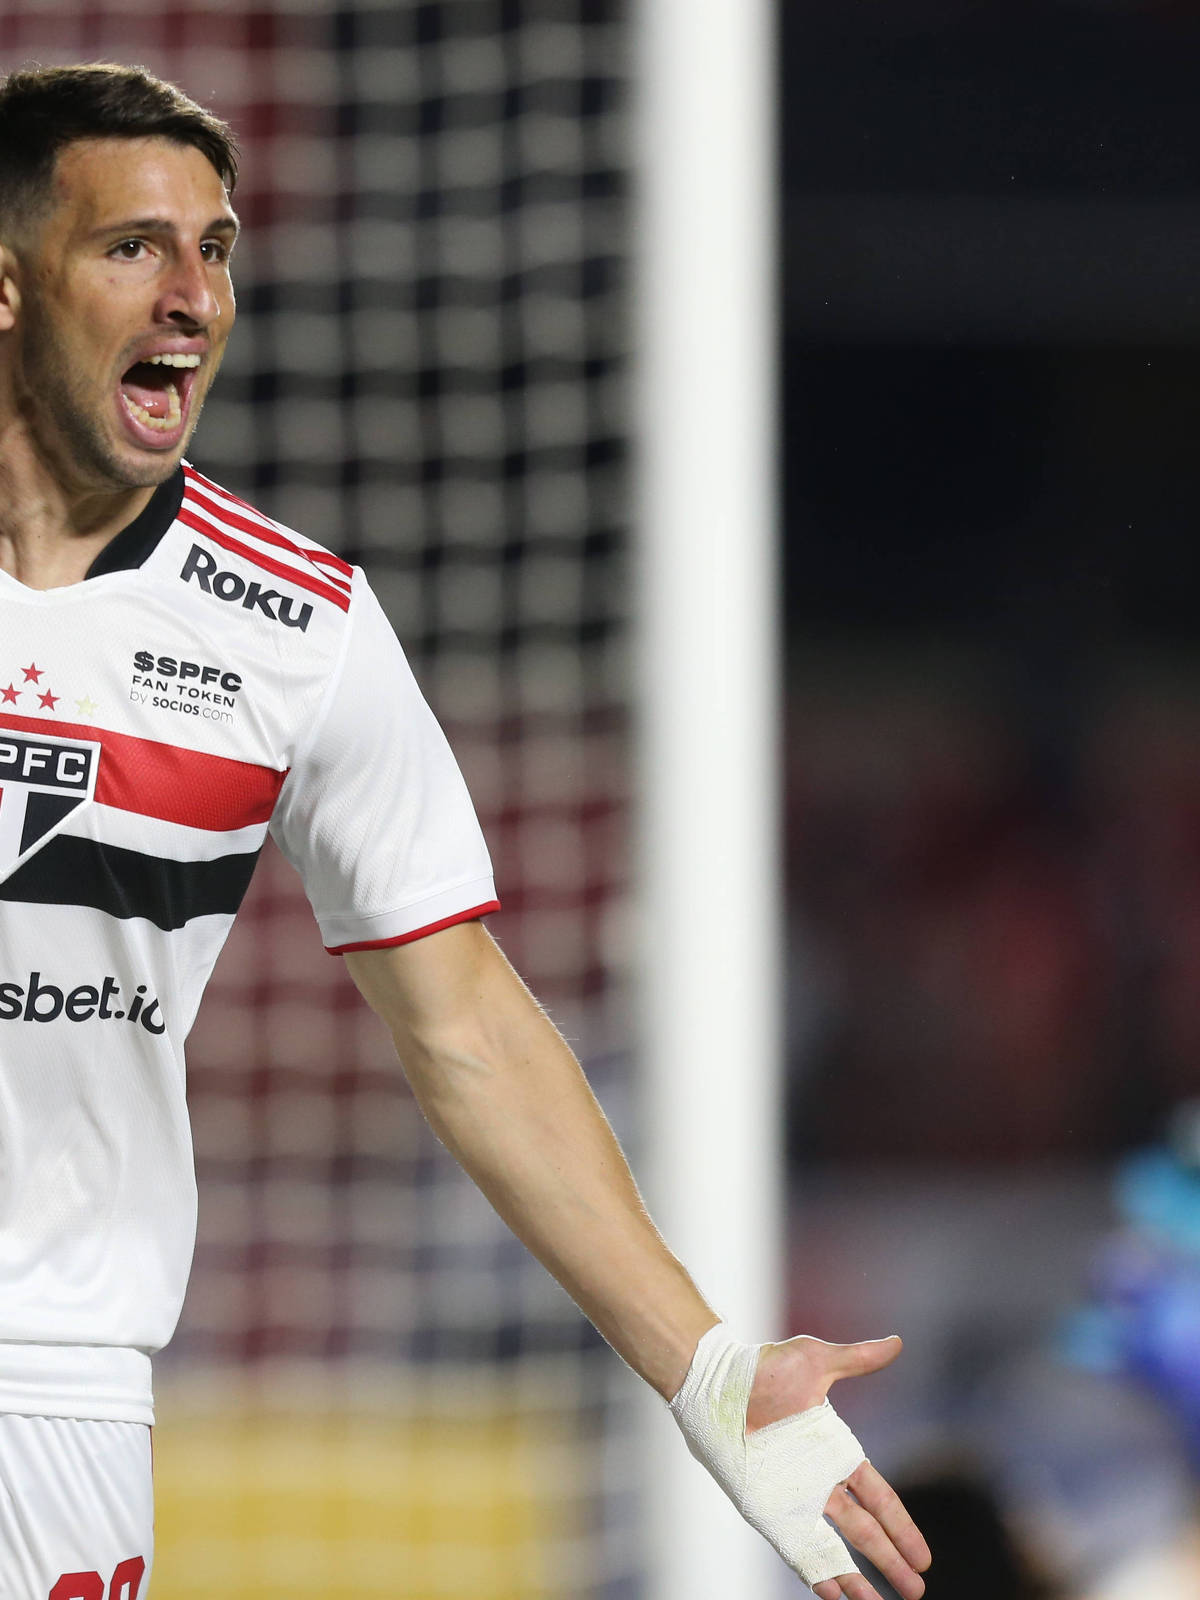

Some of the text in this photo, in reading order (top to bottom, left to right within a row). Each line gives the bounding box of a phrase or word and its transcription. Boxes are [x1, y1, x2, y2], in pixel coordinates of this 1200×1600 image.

[133, 650, 243, 692] $SPFC
[130, 687, 148, 704] by
[132, 675, 236, 708] FAN TOKEN
